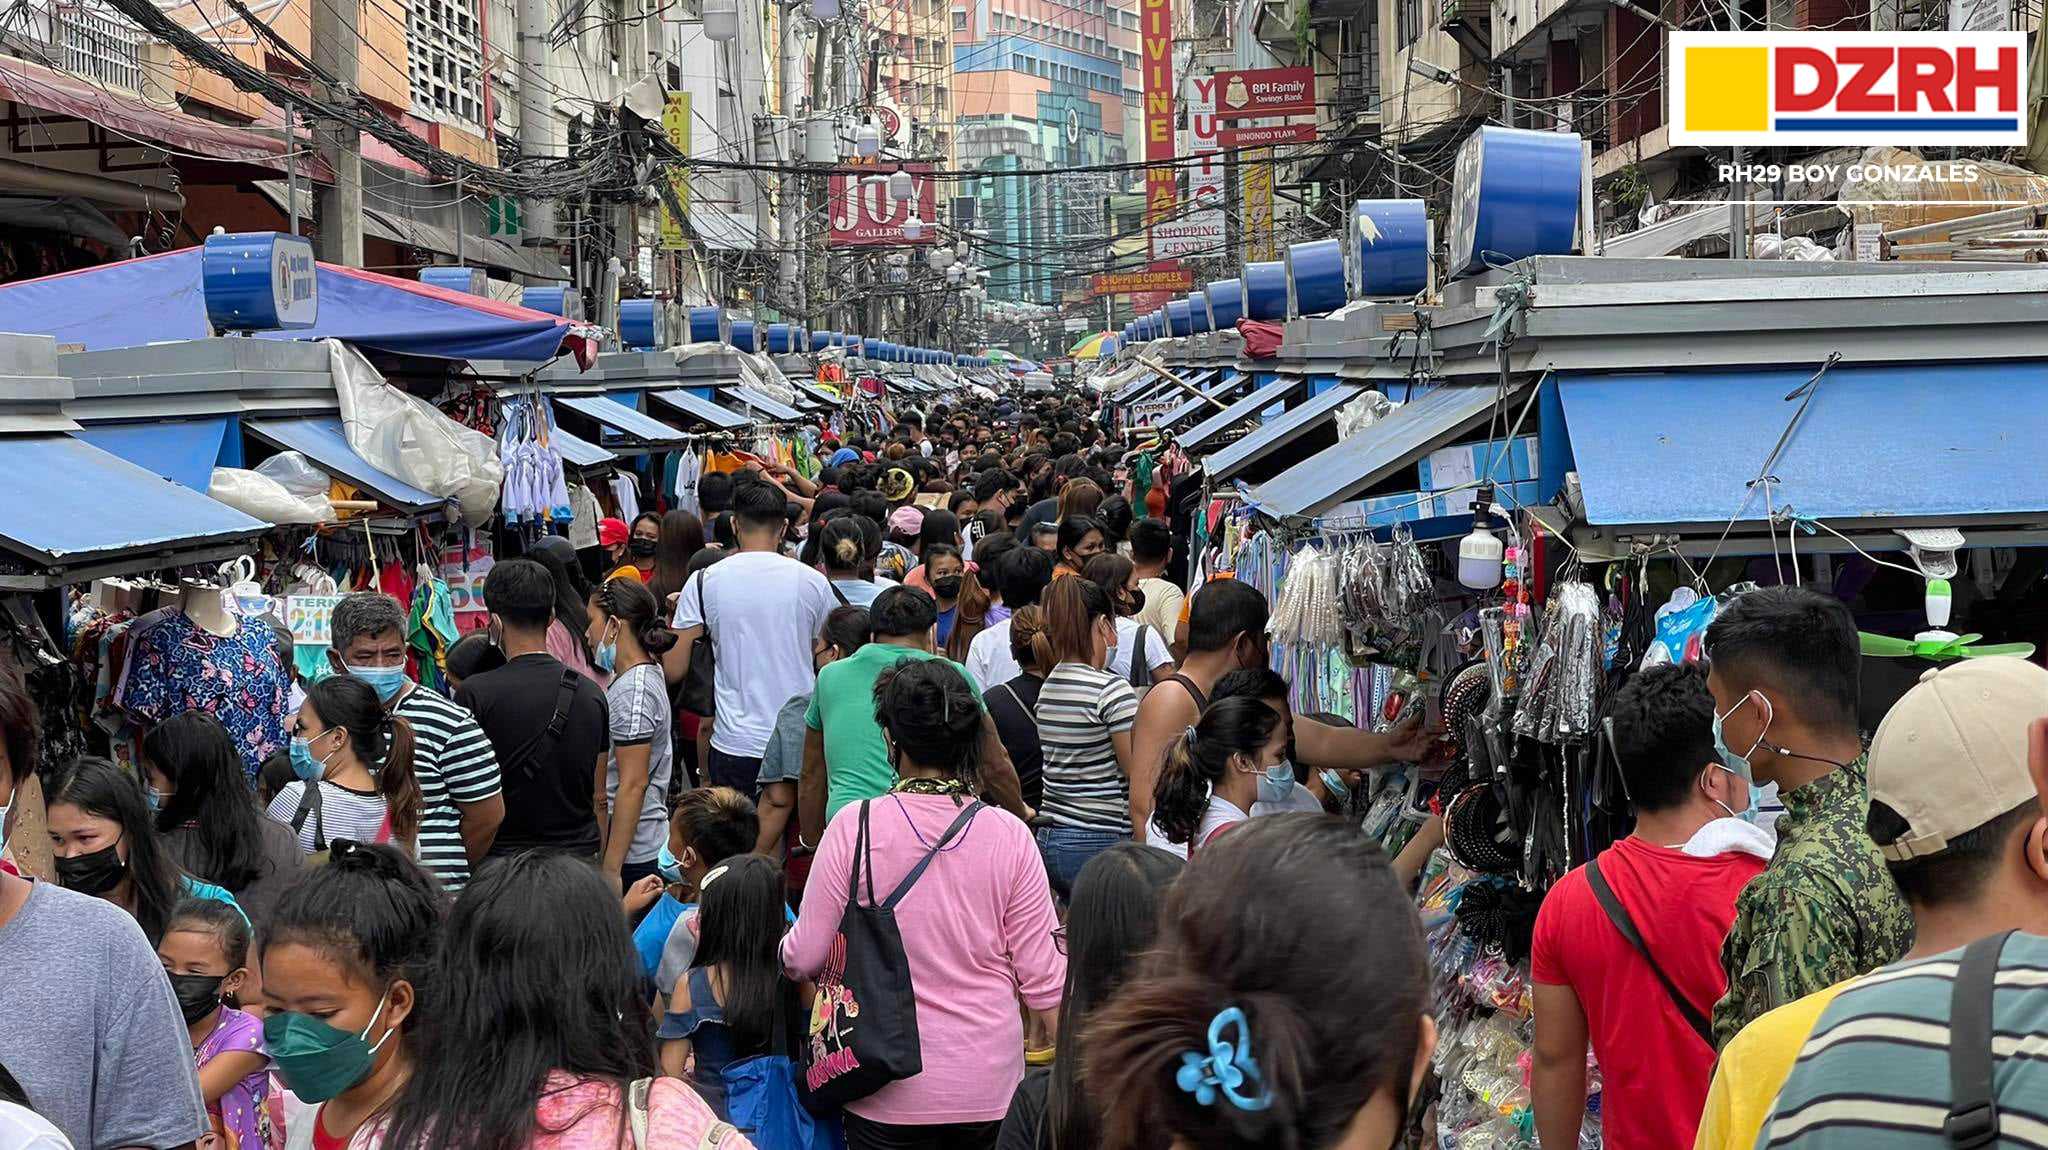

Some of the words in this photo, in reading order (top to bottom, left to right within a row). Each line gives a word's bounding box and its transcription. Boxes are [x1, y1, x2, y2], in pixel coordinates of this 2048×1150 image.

[1252, 83, 1270, 94] BPI
[1272, 80, 1305, 94] Family
[1256, 94, 1283, 103] Savings
[1284, 93, 1303, 102] Bank
[669, 97, 681, 122] MAI
[1236, 131, 1271, 141] BINONDO
[1273, 129, 1297, 139] YLAYA
[1157, 225, 1220, 239] SHOPPING
[1163, 240, 1214, 254] CENTER
[1143, 271, 1183, 283] COMPLEX
